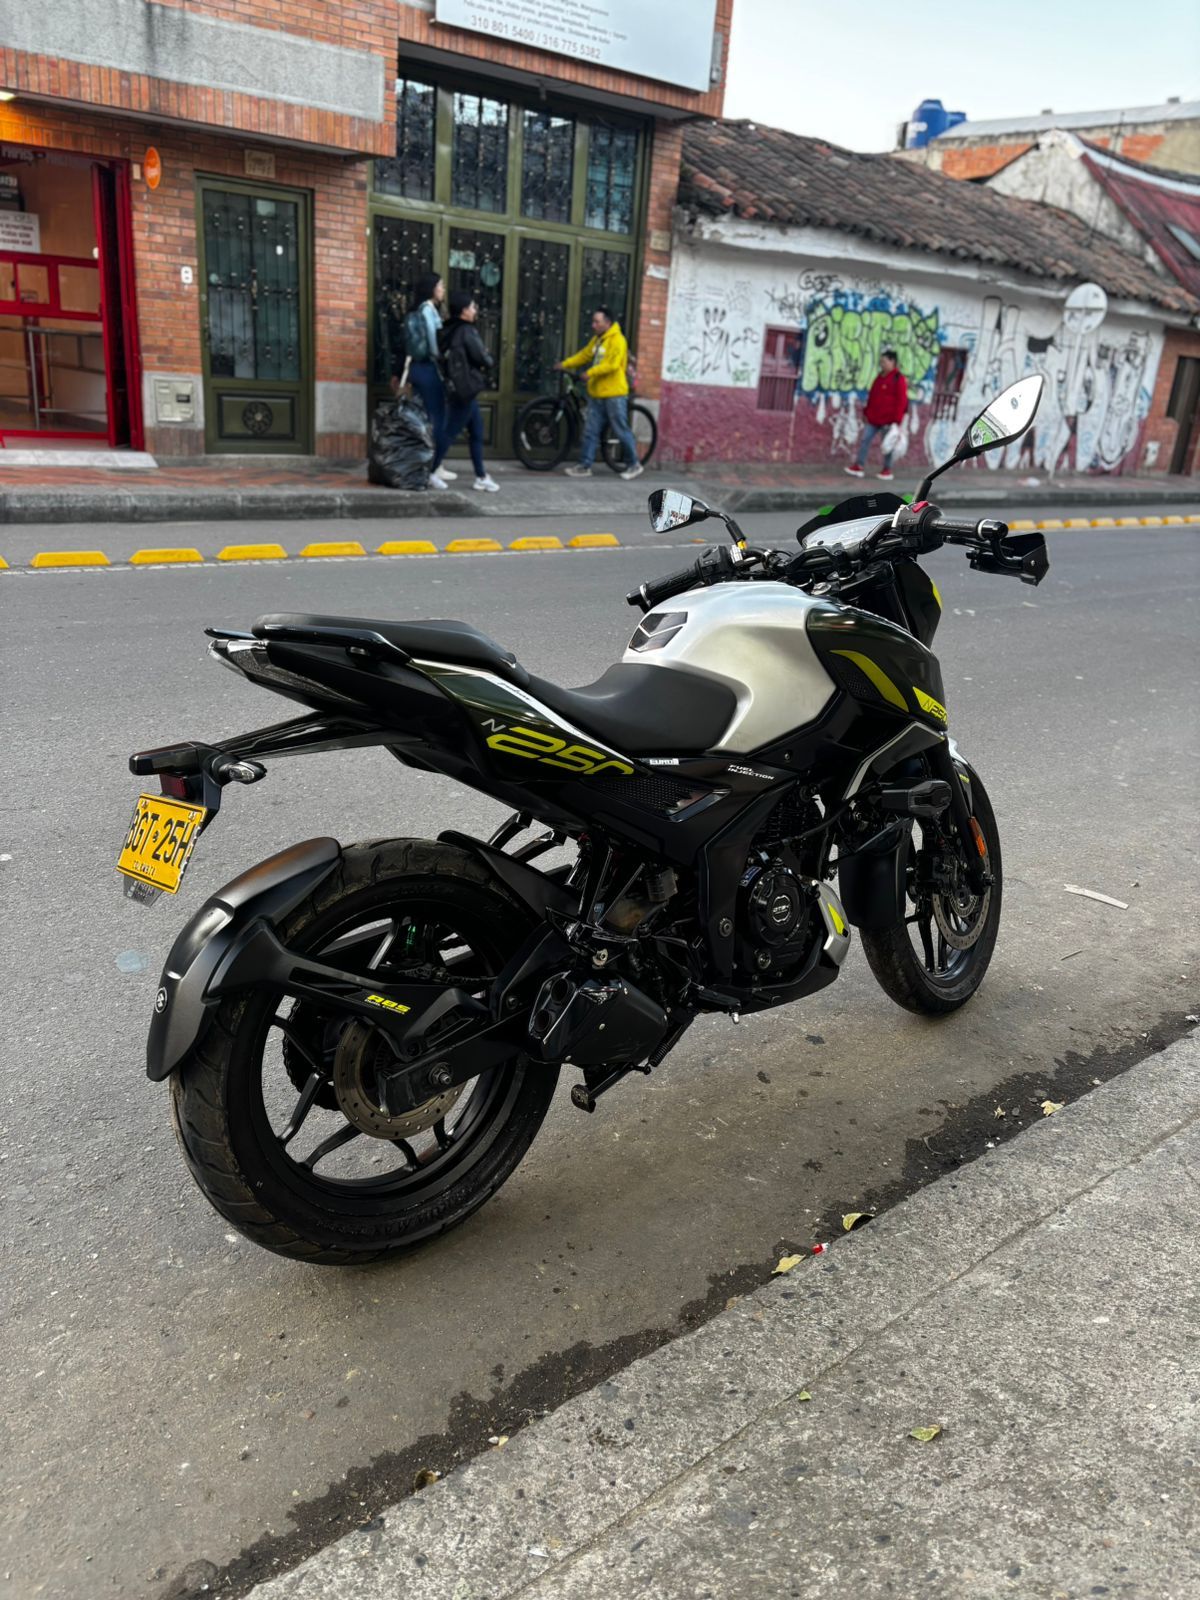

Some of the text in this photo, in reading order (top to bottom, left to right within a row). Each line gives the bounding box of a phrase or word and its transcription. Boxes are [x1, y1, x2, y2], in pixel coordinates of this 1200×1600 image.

[471, 14, 489, 30] 310
[491, 20, 509, 35] 801
[512, 25, 535, 42] 5400
[543, 33, 559, 49] 316
[561, 38, 578, 53] 775
[580, 43, 601, 60] 5382
[727, 767, 775, 780] INJECTION
[729, 764, 754, 773] FUEL
[151, 817, 197, 870] 25H
